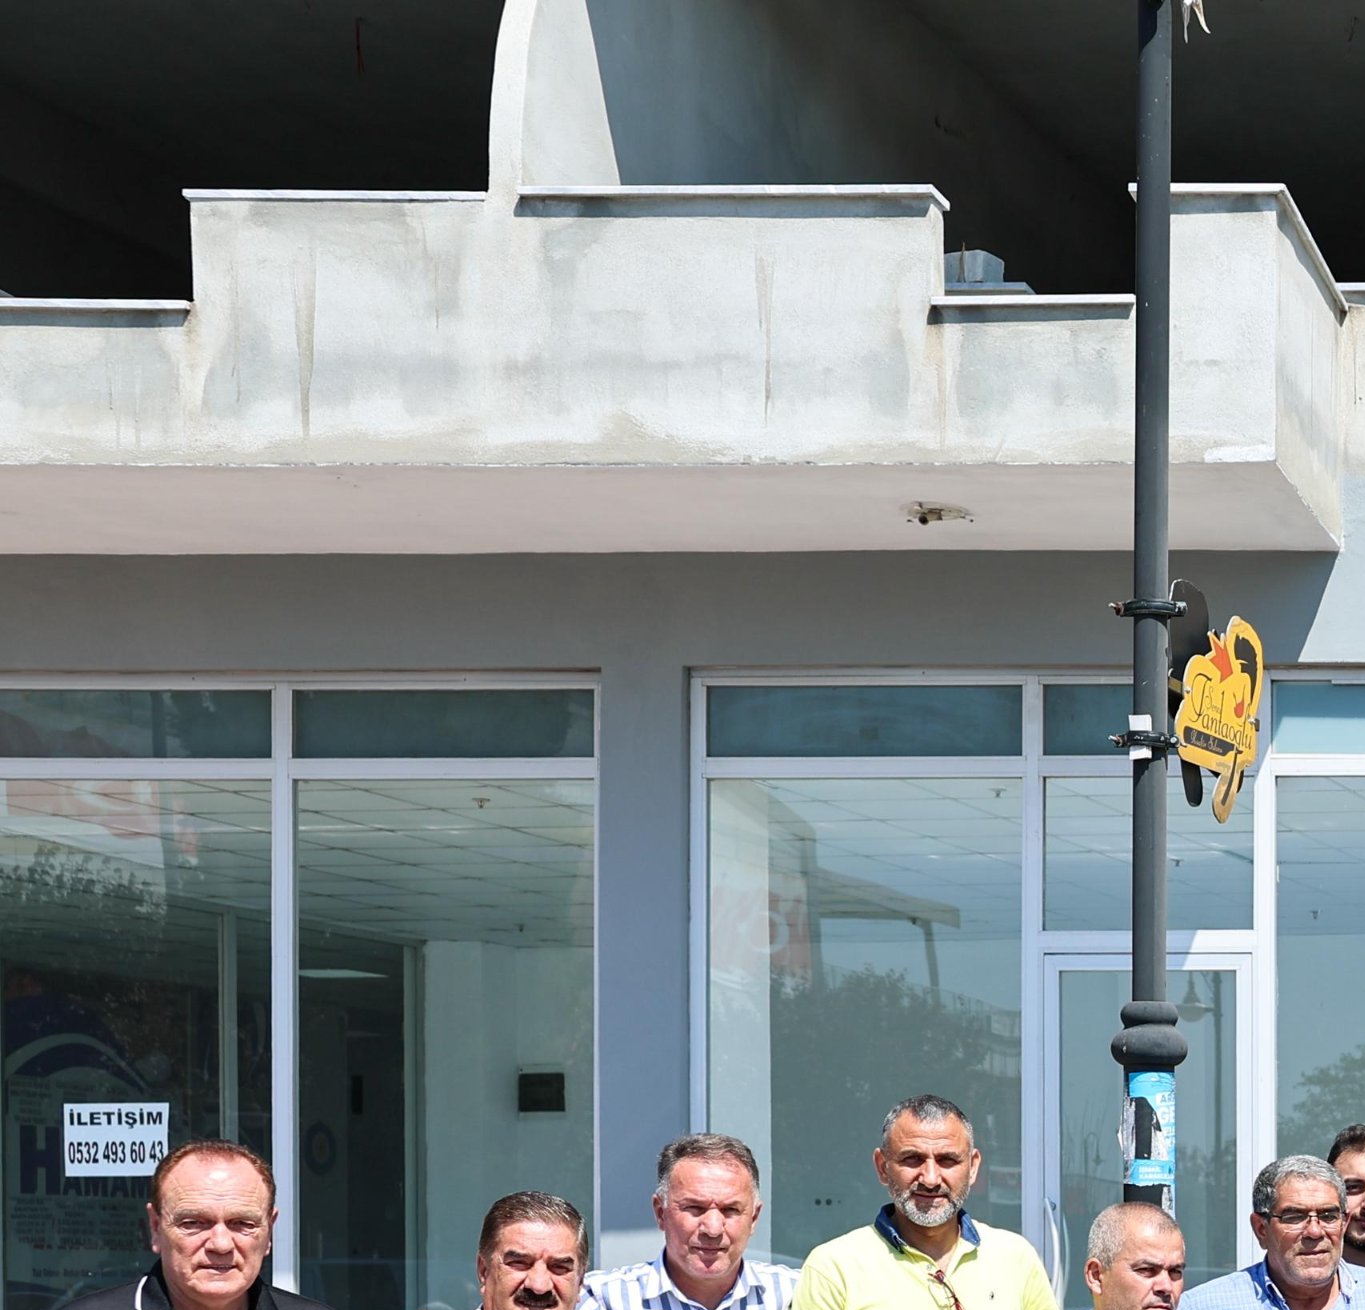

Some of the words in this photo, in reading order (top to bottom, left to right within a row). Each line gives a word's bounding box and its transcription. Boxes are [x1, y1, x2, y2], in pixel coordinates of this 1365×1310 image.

[69, 1108, 163, 1129] İLETİŞİM
[68, 1141, 99, 1164] 0532
[103, 1141, 126, 1164] 493
[130, 1141, 146, 1163] 60
[149, 1140, 164, 1163] 43
